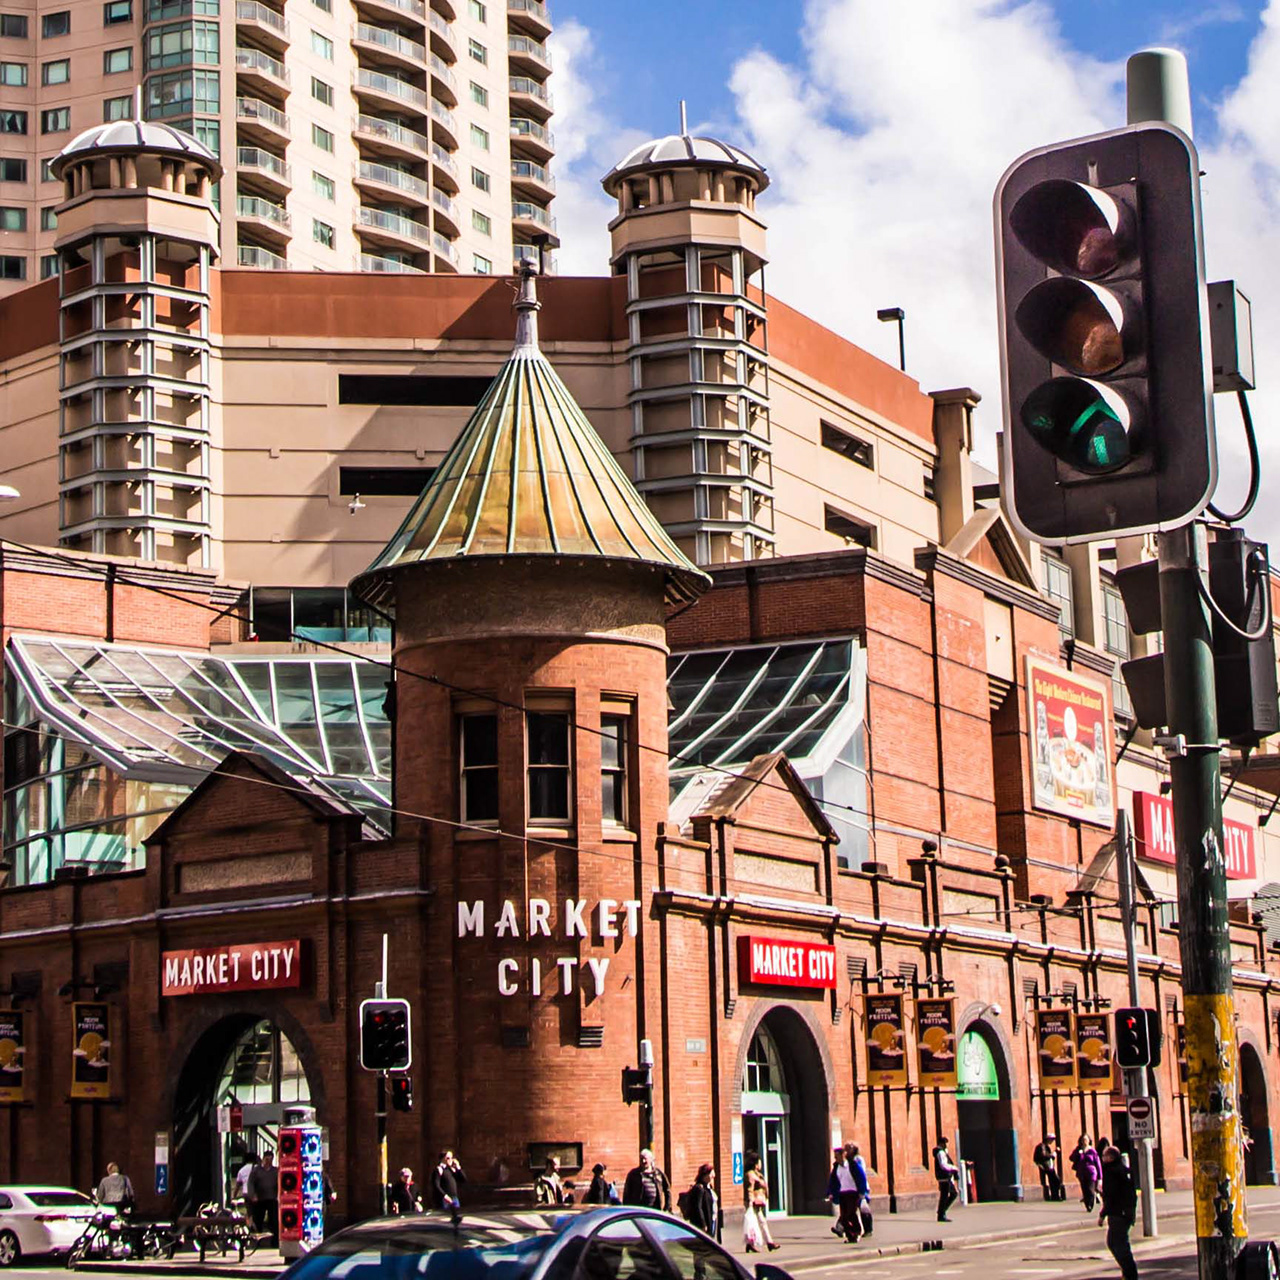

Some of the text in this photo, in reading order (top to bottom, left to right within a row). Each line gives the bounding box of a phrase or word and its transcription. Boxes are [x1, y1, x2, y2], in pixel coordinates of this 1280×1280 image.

[457, 898, 642, 938] MARKET
[165, 947, 294, 988] MARKET CITY
[497, 957, 610, 996] CITY
[752, 943, 835, 981] MARKET CITY
[1134, 1120, 1149, 1129] NO
